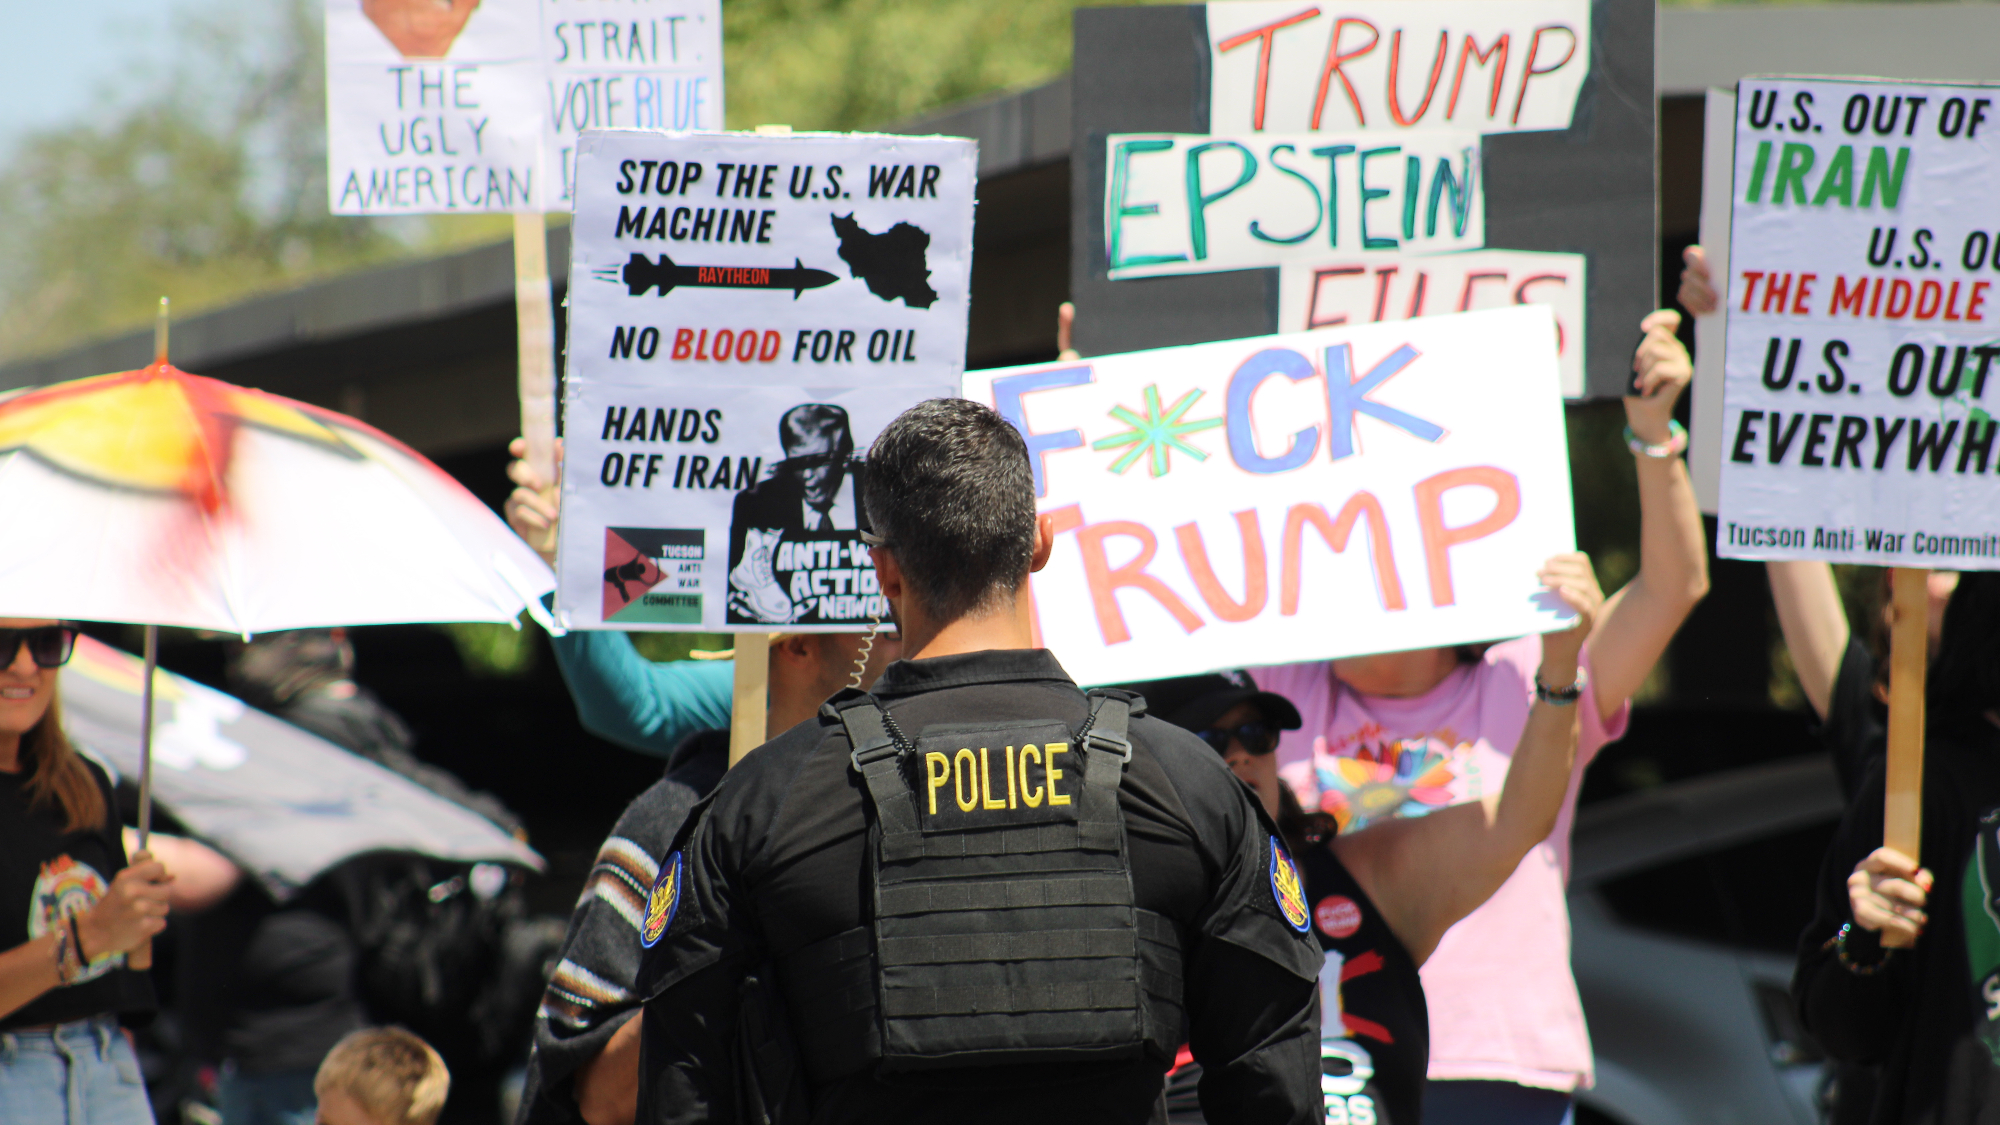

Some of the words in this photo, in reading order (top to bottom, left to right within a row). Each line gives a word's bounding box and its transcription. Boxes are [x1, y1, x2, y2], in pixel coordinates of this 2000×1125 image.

[387, 66, 479, 109] THE
[1217, 7, 1577, 131] TRUMP
[548, 77, 622, 134] VOTE
[634, 77, 709, 130] BLUE
[1748, 89, 1823, 133] U.S.
[1842, 93, 1928, 137] OUT
[1938, 97, 1991, 139] OF
[380, 117, 489, 155] UGLY
[338, 166, 531, 209] AMERICAN
[616, 159, 702, 195] STOP
[716, 163, 778, 199] THE
[789, 164, 851, 199] U.S.
[867, 164, 941, 199] WAR
[1744, 141, 1911, 210] IRAN
[1108, 139, 1479, 270] EPSTEIN
[615, 205, 776, 244] MACHINE
[1867, 227, 1942, 269] U.S.
[698, 266, 770, 285] RAYTHEON
[1740, 271, 1817, 315] THE
[1828, 275, 1991, 321] MIDDLE
[609, 326, 659, 360] NO
[671, 327, 781, 362] BLOOD
[793, 328, 855, 362] FOR
[867, 328, 916, 362] OIL
[1761, 336, 1862, 394] U.S.
[1887, 343, 2000, 400] OUT
[601, 406, 722, 444] HANDS
[1730, 410, 2000, 475] EVERYWH
[601, 452, 664, 489] OFF
[673, 455, 762, 491] IRAN
[662, 545, 703, 559] TUCSON
[776, 540, 875, 571] ANTI-W
[1728, 522, 1805, 547] Tucson
[1813, 526, 1906, 553] Anti-War
[1913, 531, 2000, 557] Commit
[678, 563, 701, 573] ANTI
[678, 579, 700, 588] WAR
[790, 568, 880, 602] ACTIO
[818, 595, 890, 619] NETWO
[926, 742, 1071, 815] POLICE
